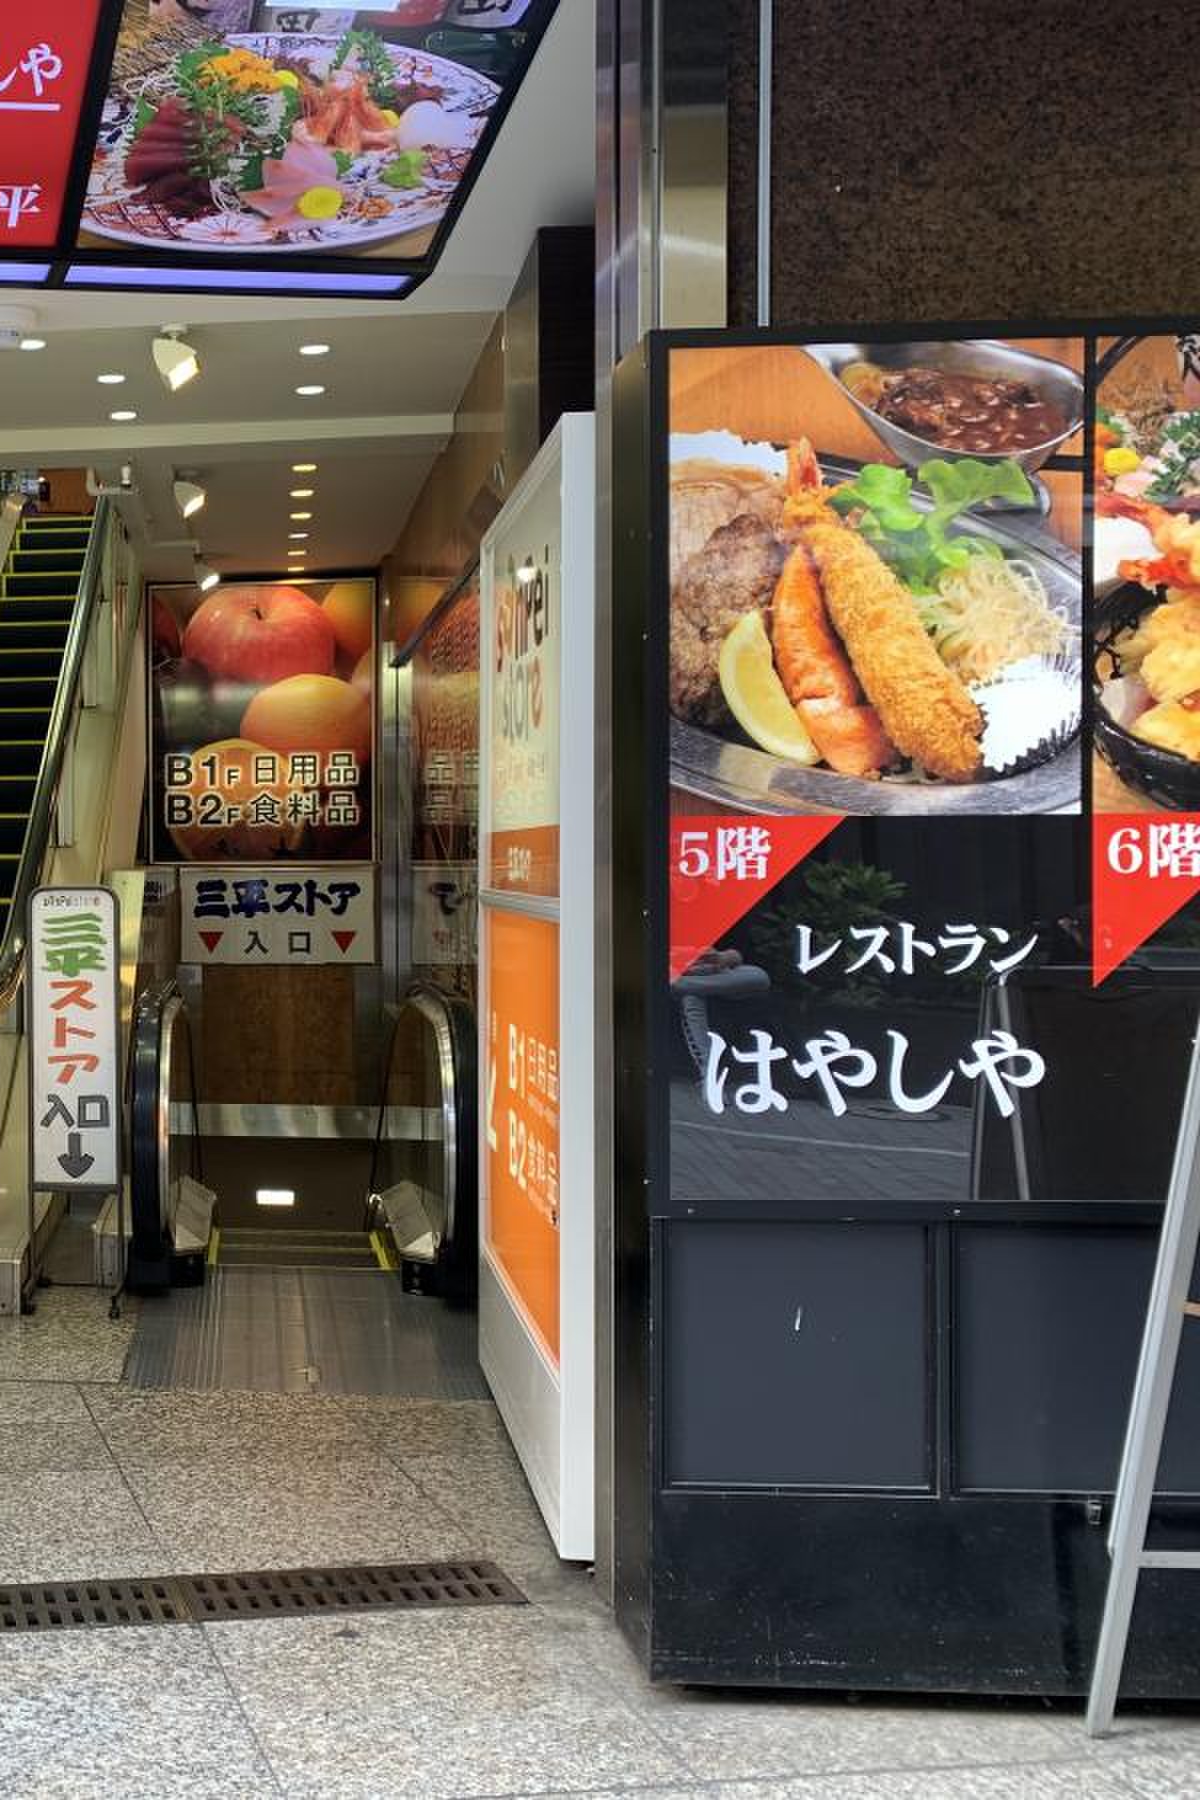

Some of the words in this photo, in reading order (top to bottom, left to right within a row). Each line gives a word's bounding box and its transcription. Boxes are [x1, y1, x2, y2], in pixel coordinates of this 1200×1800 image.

[678, 825, 771, 881] 5階
[1108, 823, 1200, 878] 6階
[244, 930, 312, 955] 入口
[793, 922, 1039, 976] レストラン
[703, 1028, 1047, 1119] はやしや
[41, 1093, 109, 1131] 入口
